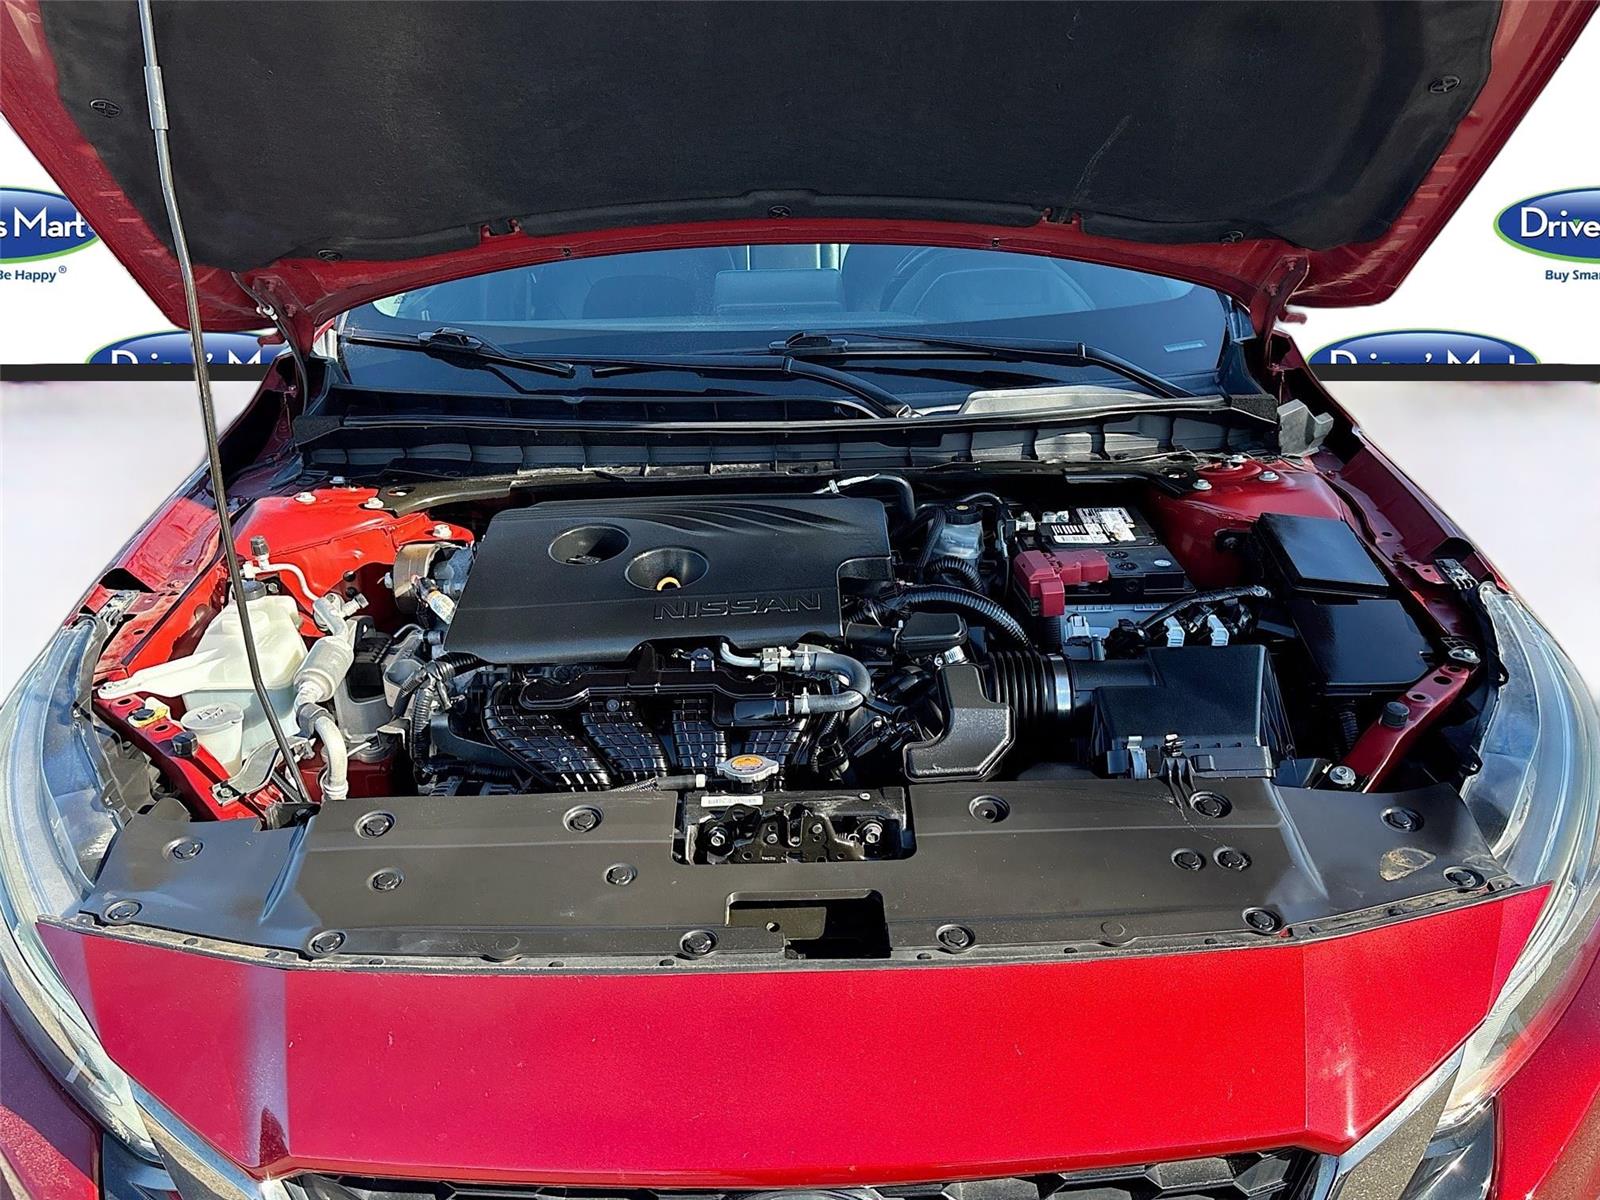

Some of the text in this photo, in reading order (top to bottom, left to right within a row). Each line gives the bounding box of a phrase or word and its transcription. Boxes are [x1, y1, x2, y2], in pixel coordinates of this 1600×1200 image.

[14, 206, 86, 238] Mart
[1521, 207, 1600, 238] Drive
[15, 270, 56, 283] Happy
[1545, 269, 1600, 283] Buy Sma
[654, 593, 821, 619] NISSAN
